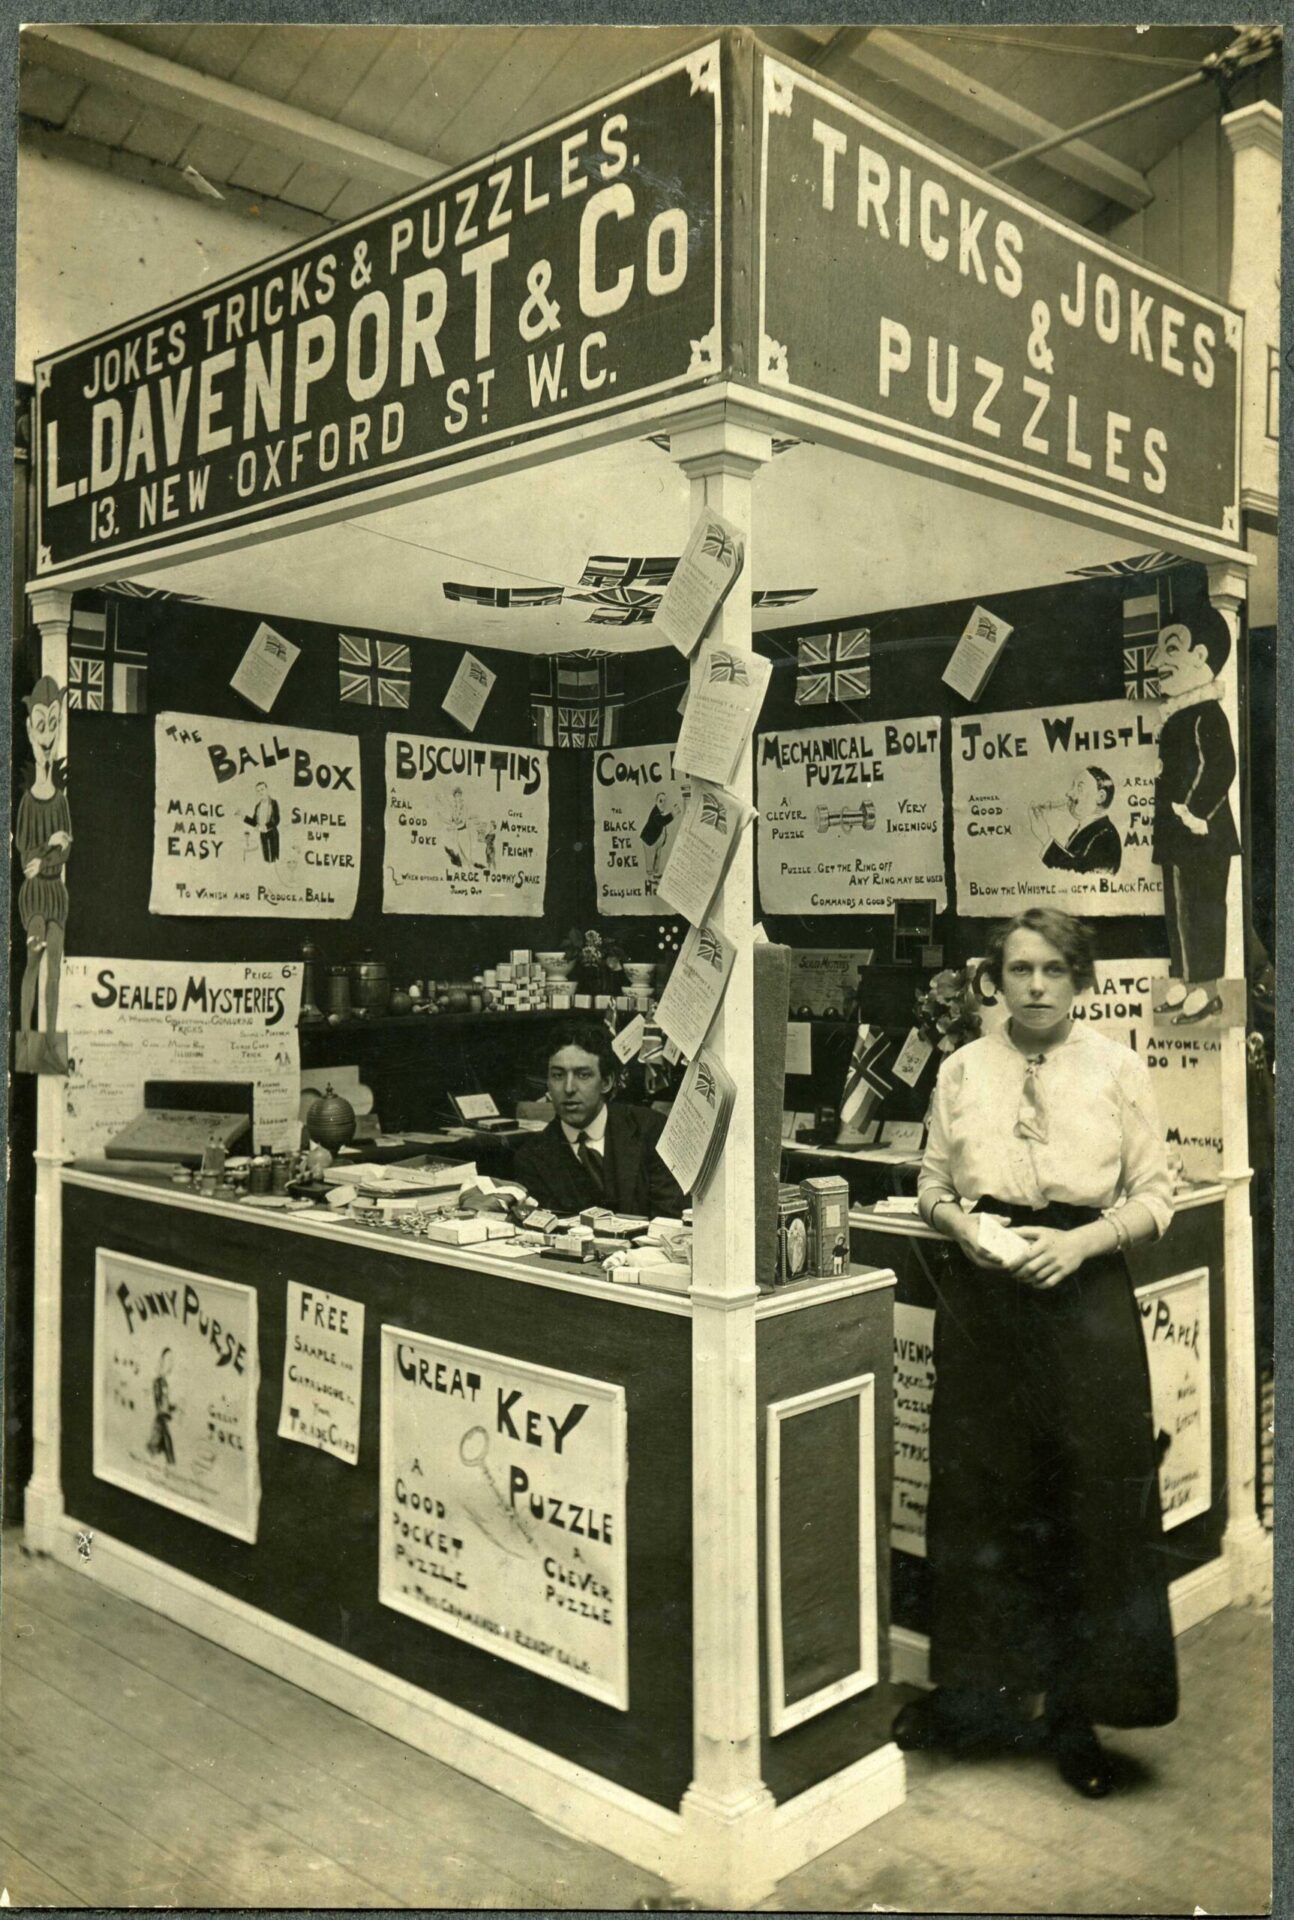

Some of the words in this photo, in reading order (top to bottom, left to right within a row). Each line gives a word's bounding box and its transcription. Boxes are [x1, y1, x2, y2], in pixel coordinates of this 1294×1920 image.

[813, 118, 1023, 298] TRICKS
[1060, 261, 1216, 389] JOKES
[518, 258, 561, 342] &
[83, 318, 186, 398] JOKES
[203, 254, 339, 349] TRICKS
[350, 240, 373, 282] &
[1027, 301, 1054, 374] &
[879, 316, 1167, 495] PUZZLES
[139, 464, 209, 529] NEW
[237, 401, 404, 498] OXFORD
[166, 725, 202, 744] THE
[961, 723, 1028, 761] JOKE
[1042, 715, 1160, 753] WHISTL
[762, 735, 873, 769] MECHANICAL
[885, 726, 937, 756] BOLT
[208, 736, 290, 783] BALL
[294, 749, 356, 791] BOX
[396, 740, 486, 781] BISCUIT
[490, 751, 541, 795] TINS
[596, 752, 662, 786] COMIC
[806, 761, 884, 787] PUZZLE
[1123, 778, 1132, 787] A
[1134, 776, 1155, 786] REA
[167, 800, 225, 818] MAGIC
[390, 797, 412, 809] REAL
[898, 800, 927, 814] VERY
[1128, 795, 1155, 807] GOO
[291, 807, 346, 826] SIMPLE
[399, 814, 428, 826] GOOD
[766, 811, 806, 820] CLEVER
[971, 806, 1003, 816] GOOD
[1130, 812, 1155, 828] FU
[173, 822, 216, 835] MADE
[500, 821, 538, 834] MOTHER
[603, 820, 636, 832] BLACK
[772, 828, 804, 839] PUZZLE
[887, 819, 938, 833] INGENIOUS
[967, 822, 1012, 836] CATCH
[308, 831, 329, 842] BUT
[411, 830, 436, 845] JOKE
[612, 836, 631, 849] EYE
[1124, 832, 1154, 847] MA
[168, 837, 223, 859] EASY
[502, 842, 533, 857] FRIGHT
[305, 850, 355, 867] CLEVER
[607, 852, 638, 867] JOKE
[818, 864, 835, 874] GET
[837, 864, 851, 872] THE
[855, 859, 877, 871] RING
[880, 861, 893, 871] OFF
[446, 869, 479, 882] LARGE
[849, 875, 869, 886] ANY
[873, 874, 895, 885] RING
[897, 876, 913, 884] MAY
[257, 885, 297, 905] PRODUCE
[306, 888, 335, 903] BALL
[602, 885, 624, 898] SELLS
[970, 882, 999, 896] BLOW
[1001, 887, 1016, 895] THE
[1018, 881, 1056, 895] WHISTLE
[1099, 879, 1136, 893] BLACK
[1138, 877, 1163, 892] FACE
[811, 894, 855, 908] COMMANDS
[91, 970, 177, 1009] SEALED
[182, 976, 285, 1026] MYSTERIES
[1147, 1037, 1200, 1050] ANYONE
[1148, 1055, 1168, 1068] DO
[1182, 1055, 1198, 1068] IT
[1166, 1127, 1223, 1153] MATCHES
[301, 1291, 349, 1335] FREE
[116, 1282, 177, 1335] FUNNY
[183, 1284, 248, 1376] PURSE
[1152, 1297, 1200, 1360] PAPER
[294, 1335, 336, 1365] SAMPLE
[397, 1343, 482, 1402] GREAT
[496, 1387, 590, 1455] KEY
[411, 1458, 424, 1477] A
[395, 1478, 446, 1519] GOOD
[509, 1464, 614, 1546] PUZZLE
[393, 1512, 464, 1557] POCKET
[572, 1546, 584, 1564] A
[395, 1544, 468, 1590] PUZZLE
[543, 1556, 613, 1603] CLEVER
[546, 1587, 612, 1626] PUZZLE
